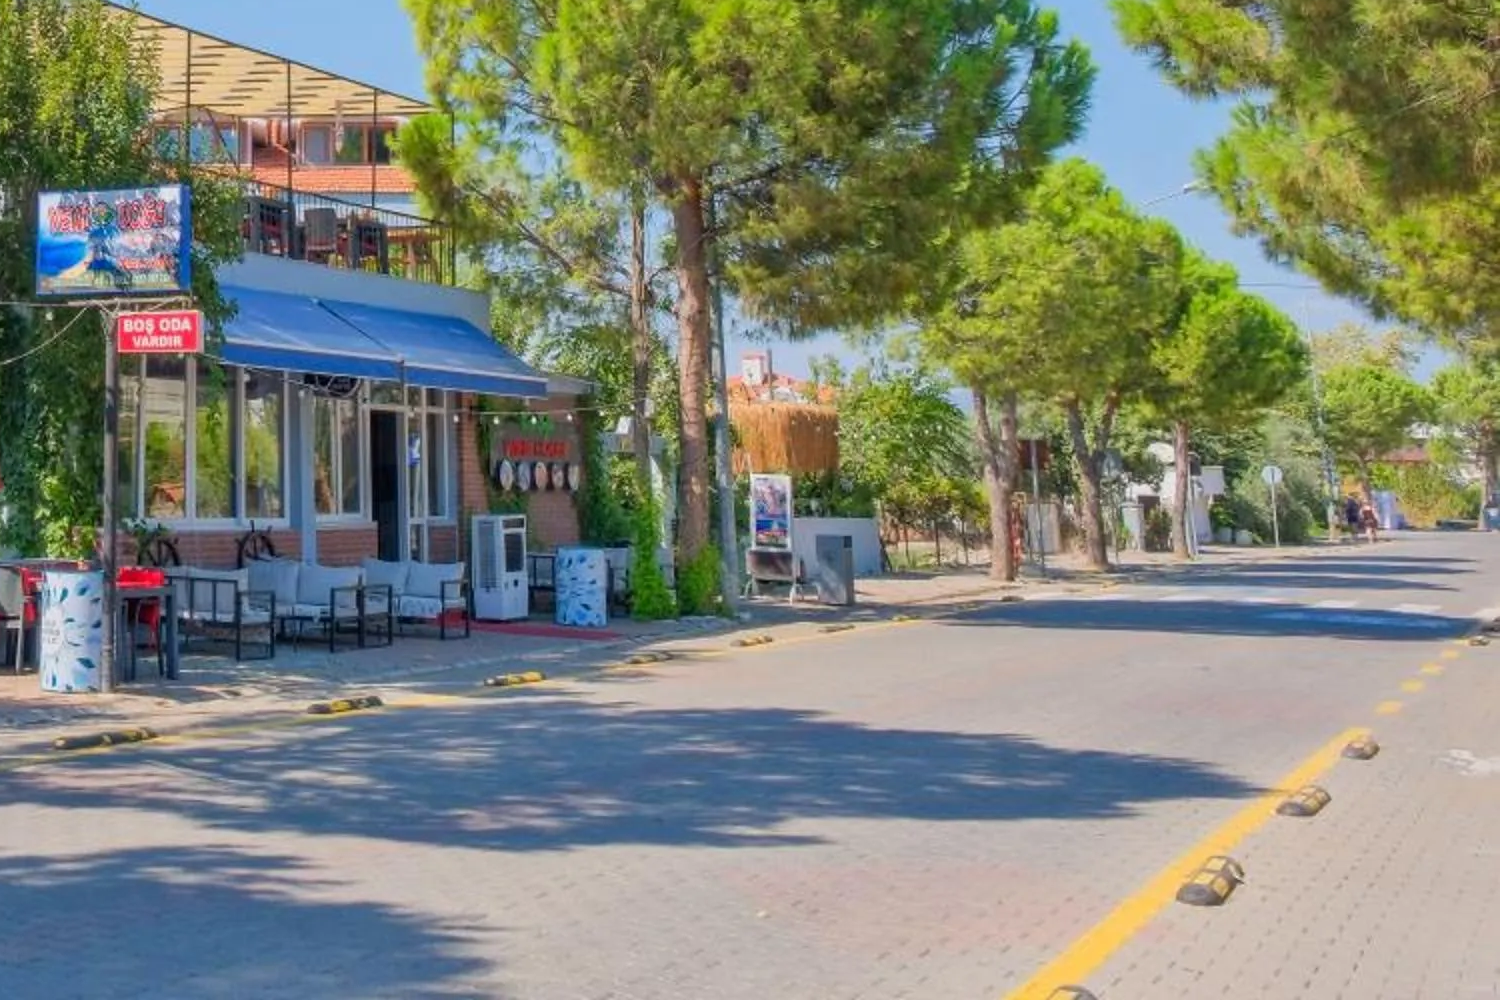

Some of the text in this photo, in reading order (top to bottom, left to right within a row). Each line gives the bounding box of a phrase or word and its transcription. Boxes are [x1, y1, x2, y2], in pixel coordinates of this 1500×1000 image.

[123, 316, 192, 335] BOŞ ODA
[132, 335, 183, 348] VARDIR
